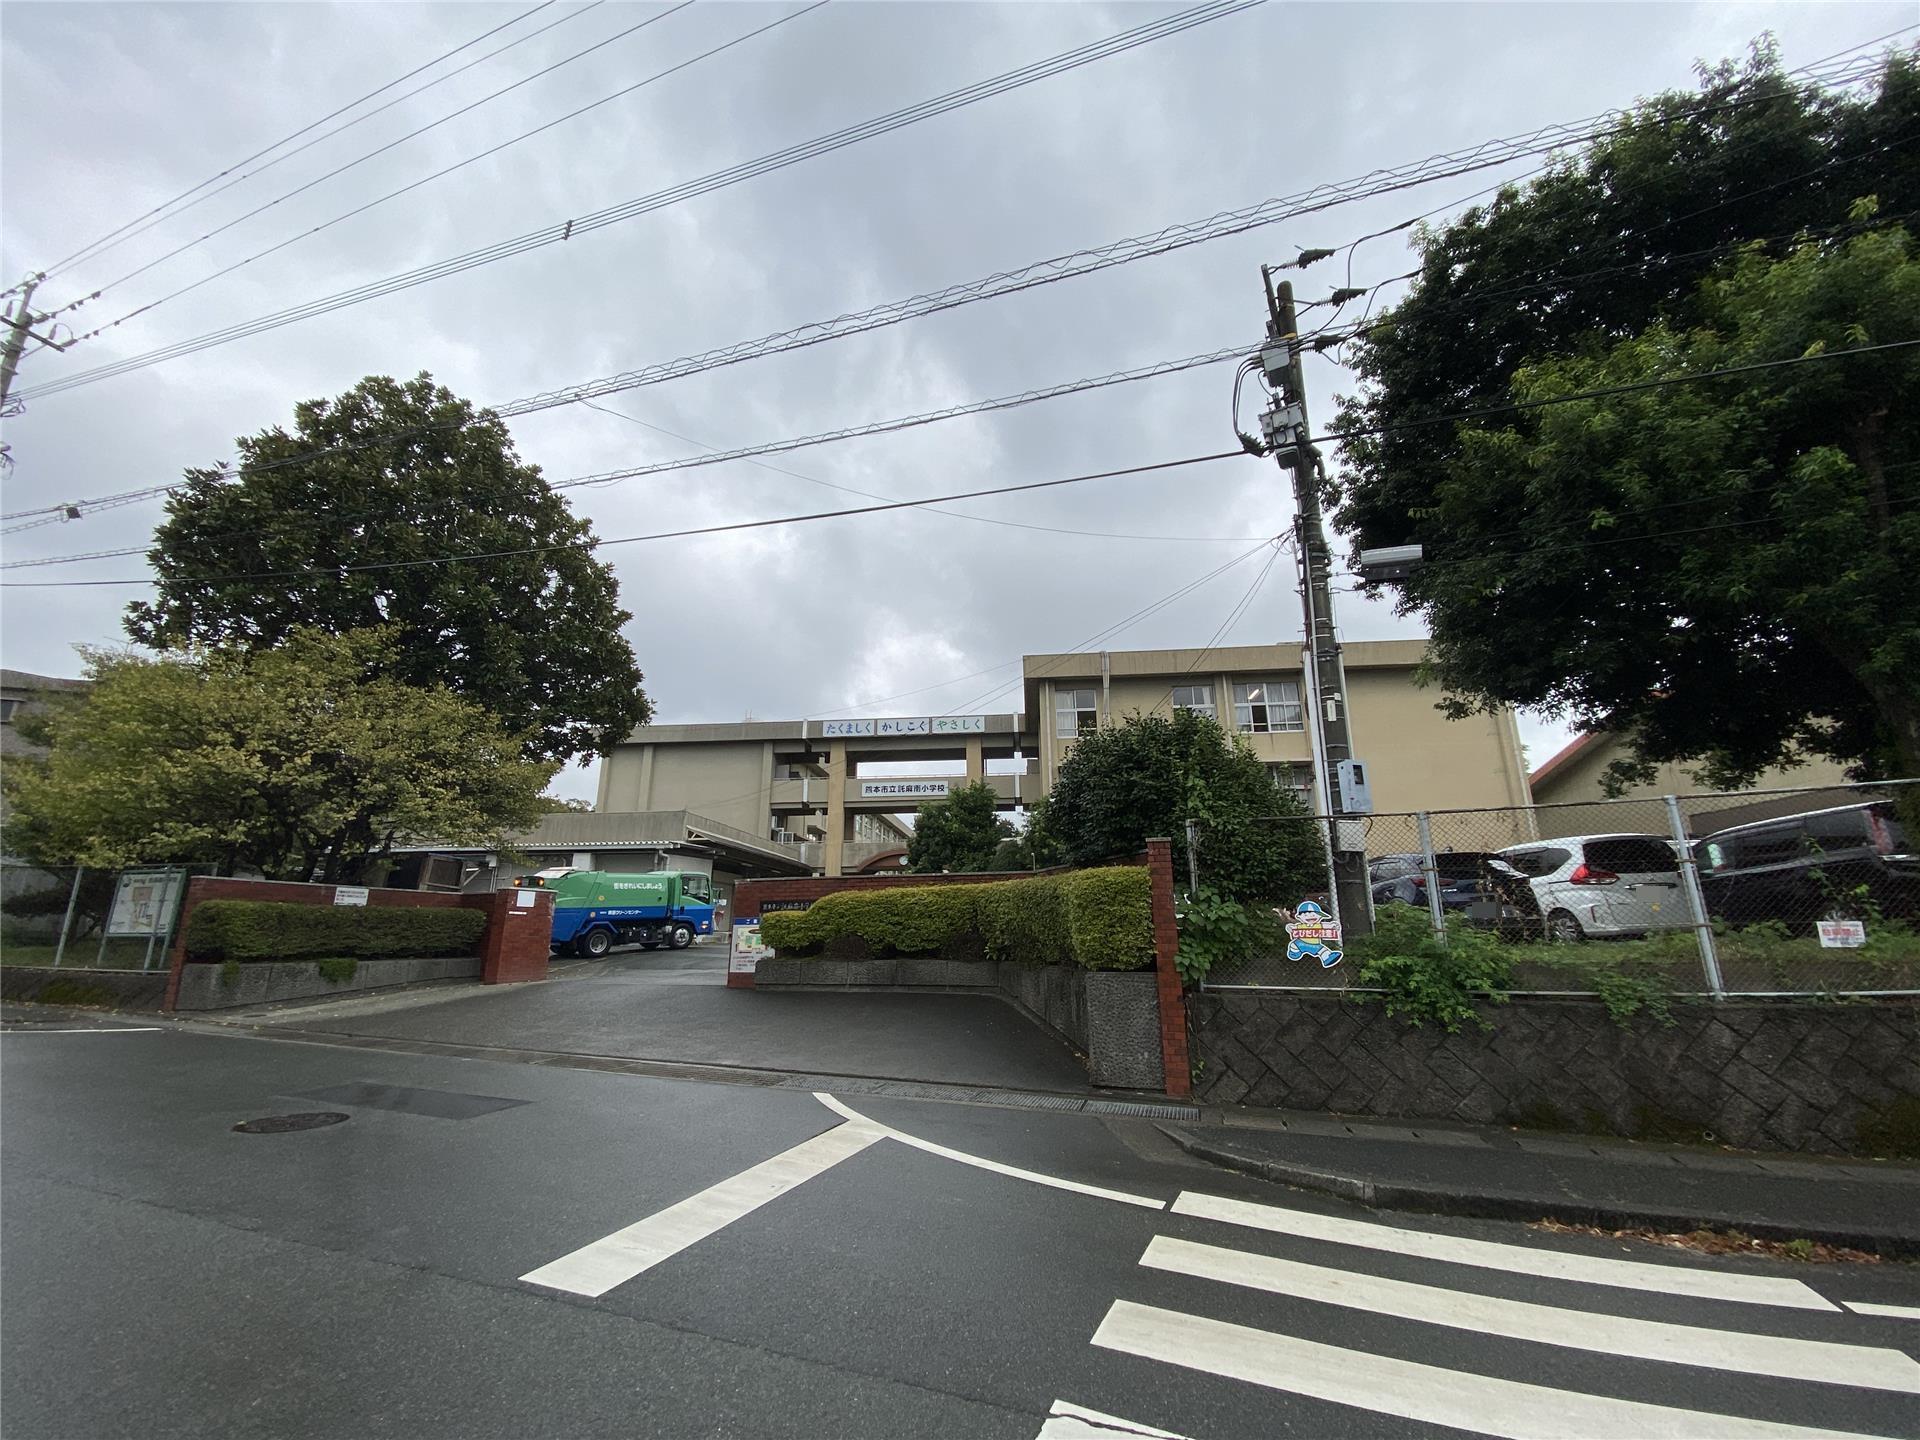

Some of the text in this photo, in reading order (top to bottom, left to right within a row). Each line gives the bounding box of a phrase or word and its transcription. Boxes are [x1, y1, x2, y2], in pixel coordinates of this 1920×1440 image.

[826, 722, 871, 735] たくましく
[881, 720, 926, 733] かしこく
[936, 718, 981, 731] やさしく
[865, 784, 945, 794] 熊本市立託麻南小学校
